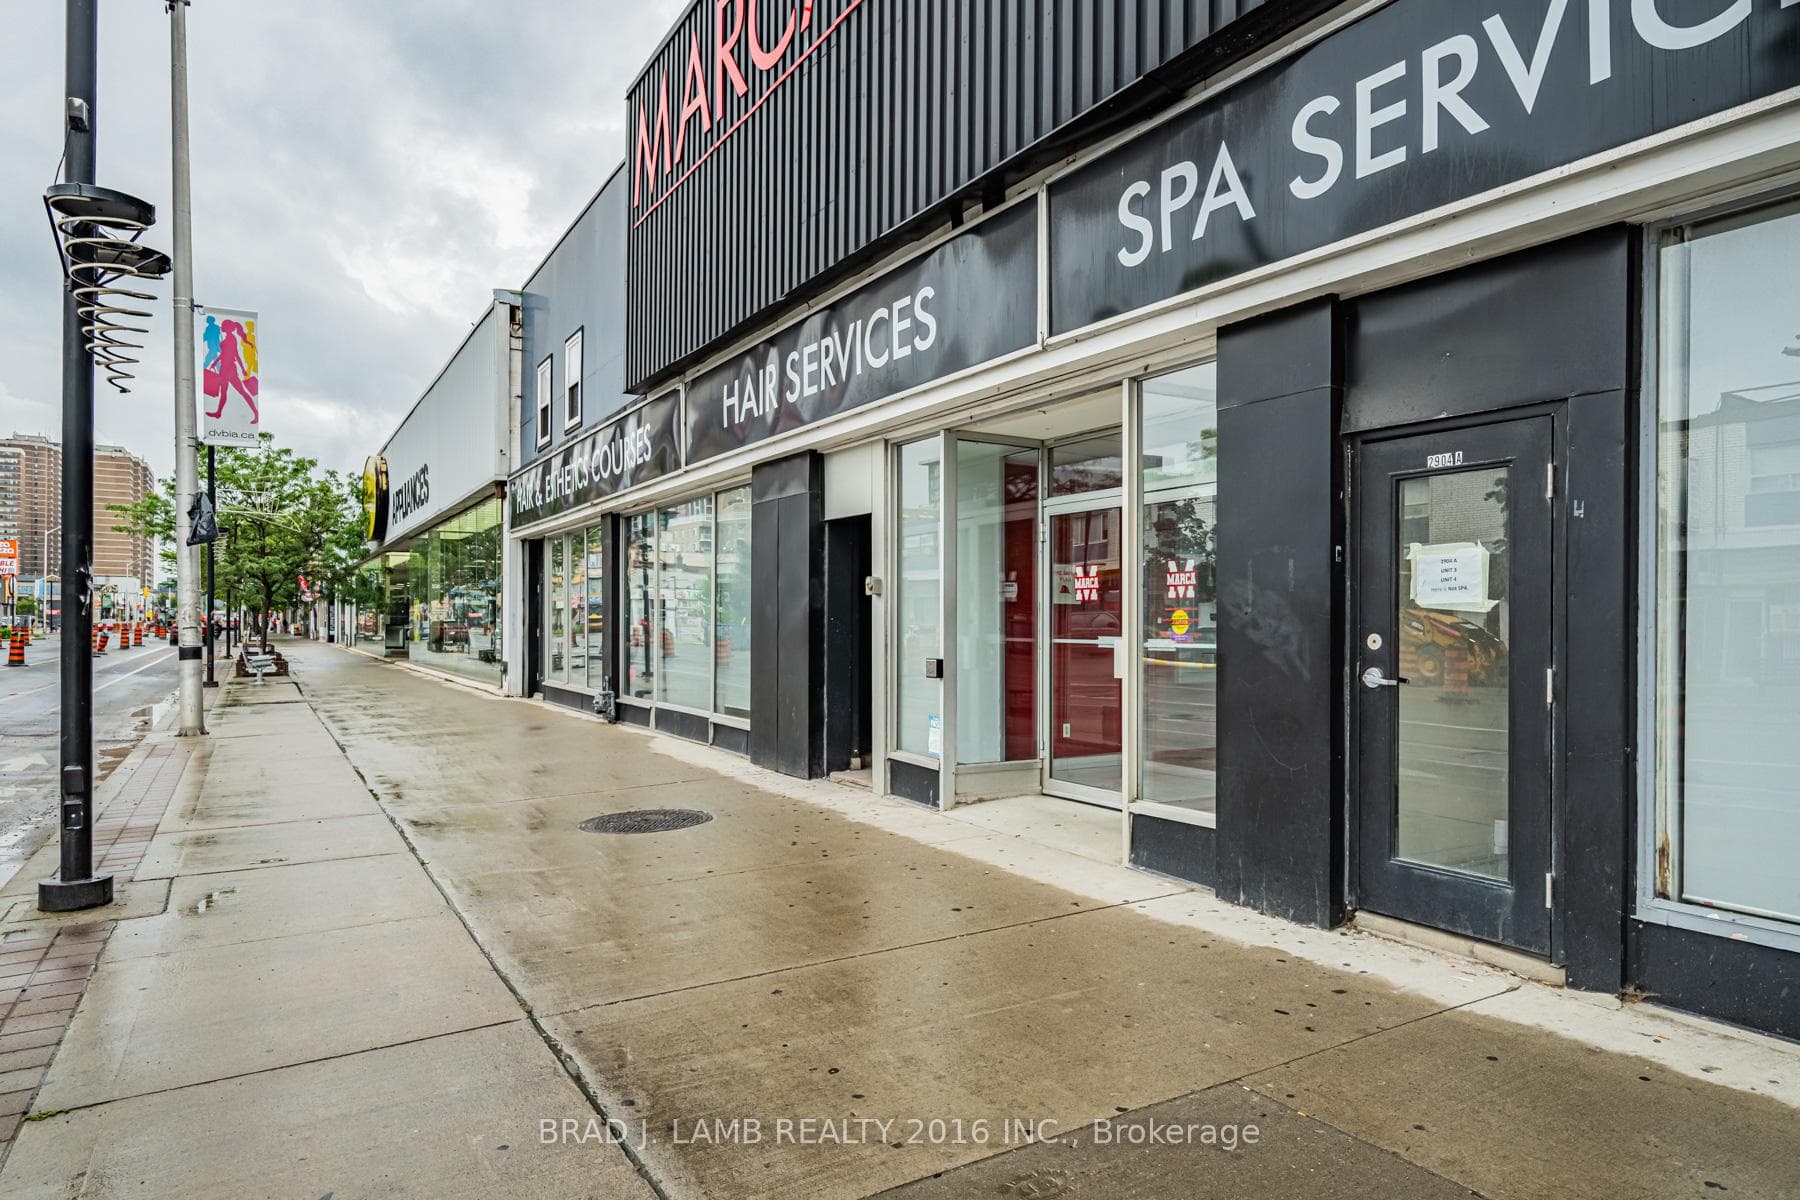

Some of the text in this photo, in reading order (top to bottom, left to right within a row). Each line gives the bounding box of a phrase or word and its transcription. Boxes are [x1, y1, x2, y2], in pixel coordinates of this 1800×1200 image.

[633, 0, 813, 208] MARC
[1117, 0, 1800, 268] SPA SERVI
[723, 286, 937, 428] HAIR SERVICES
[208, 429, 255, 439] dvbia.ca
[1428, 454, 1452, 468] 2904
[391, 463, 430, 526] APPLIANCES
[516, 423, 651, 514] HAIR & ESTHETICS COURSES
[1074, 577, 1099, 589] MARCA
[1167, 572, 1196, 586] MARCA
